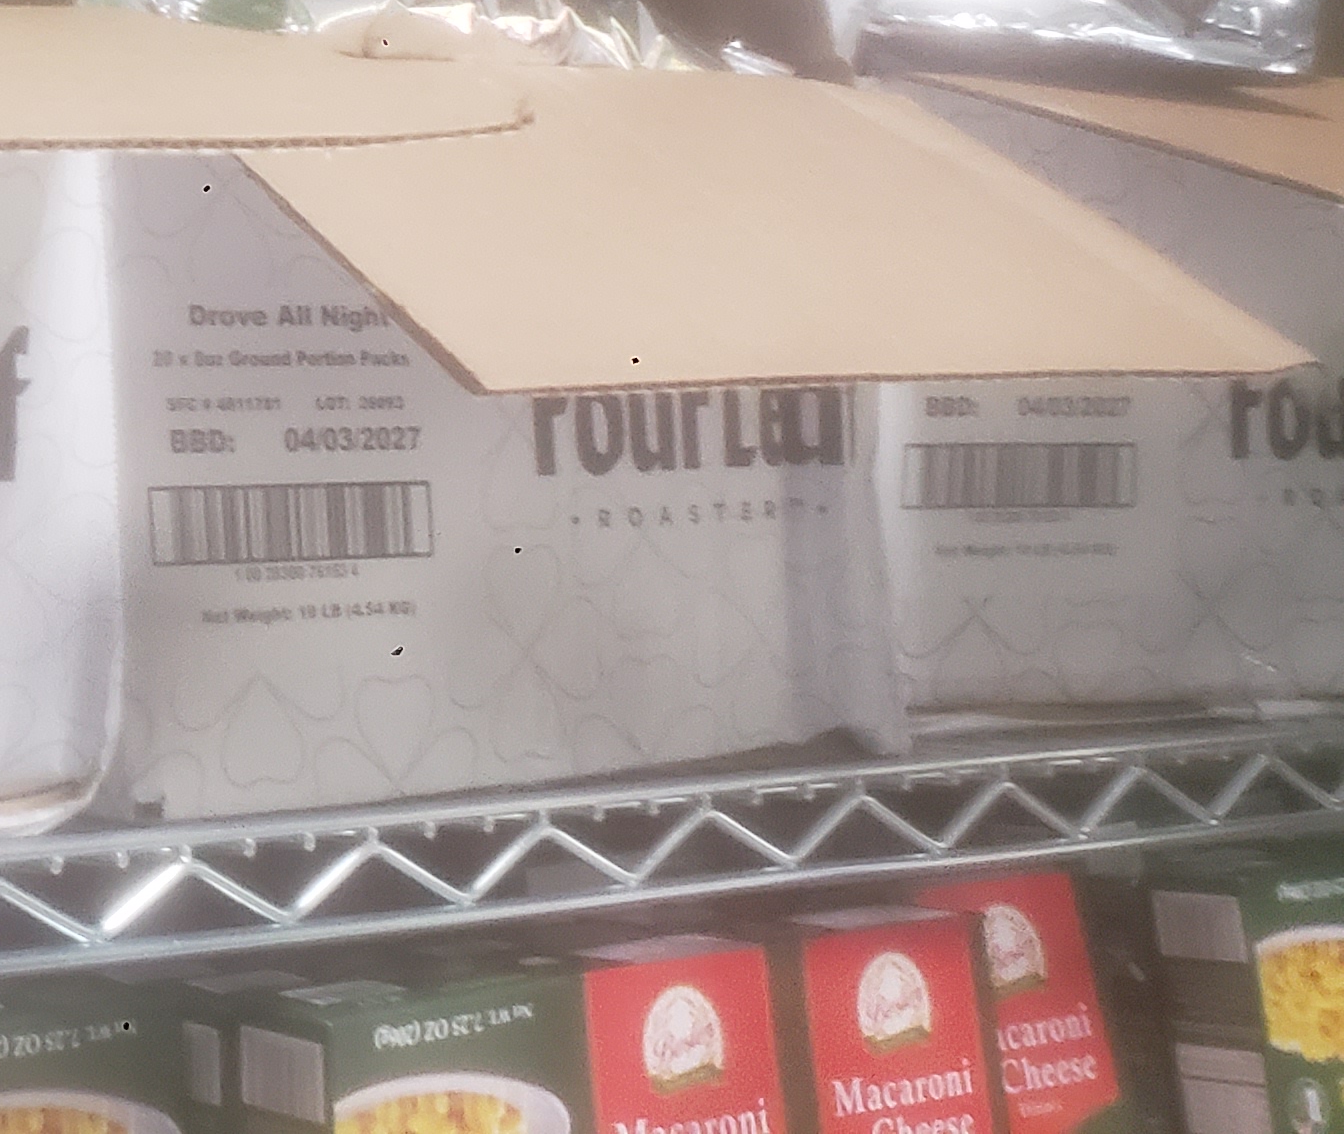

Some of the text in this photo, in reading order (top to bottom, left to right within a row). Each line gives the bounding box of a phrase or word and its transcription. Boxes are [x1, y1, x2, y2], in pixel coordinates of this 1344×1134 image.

[187, 304, 268, 327] Drove
[278, 304, 312, 327] All
[169, 424, 423, 454] BBD: 04/03/2027
[831, 1056, 974, 1117] Macaroni
[1001, 1052, 1097, 1094] Cheese
